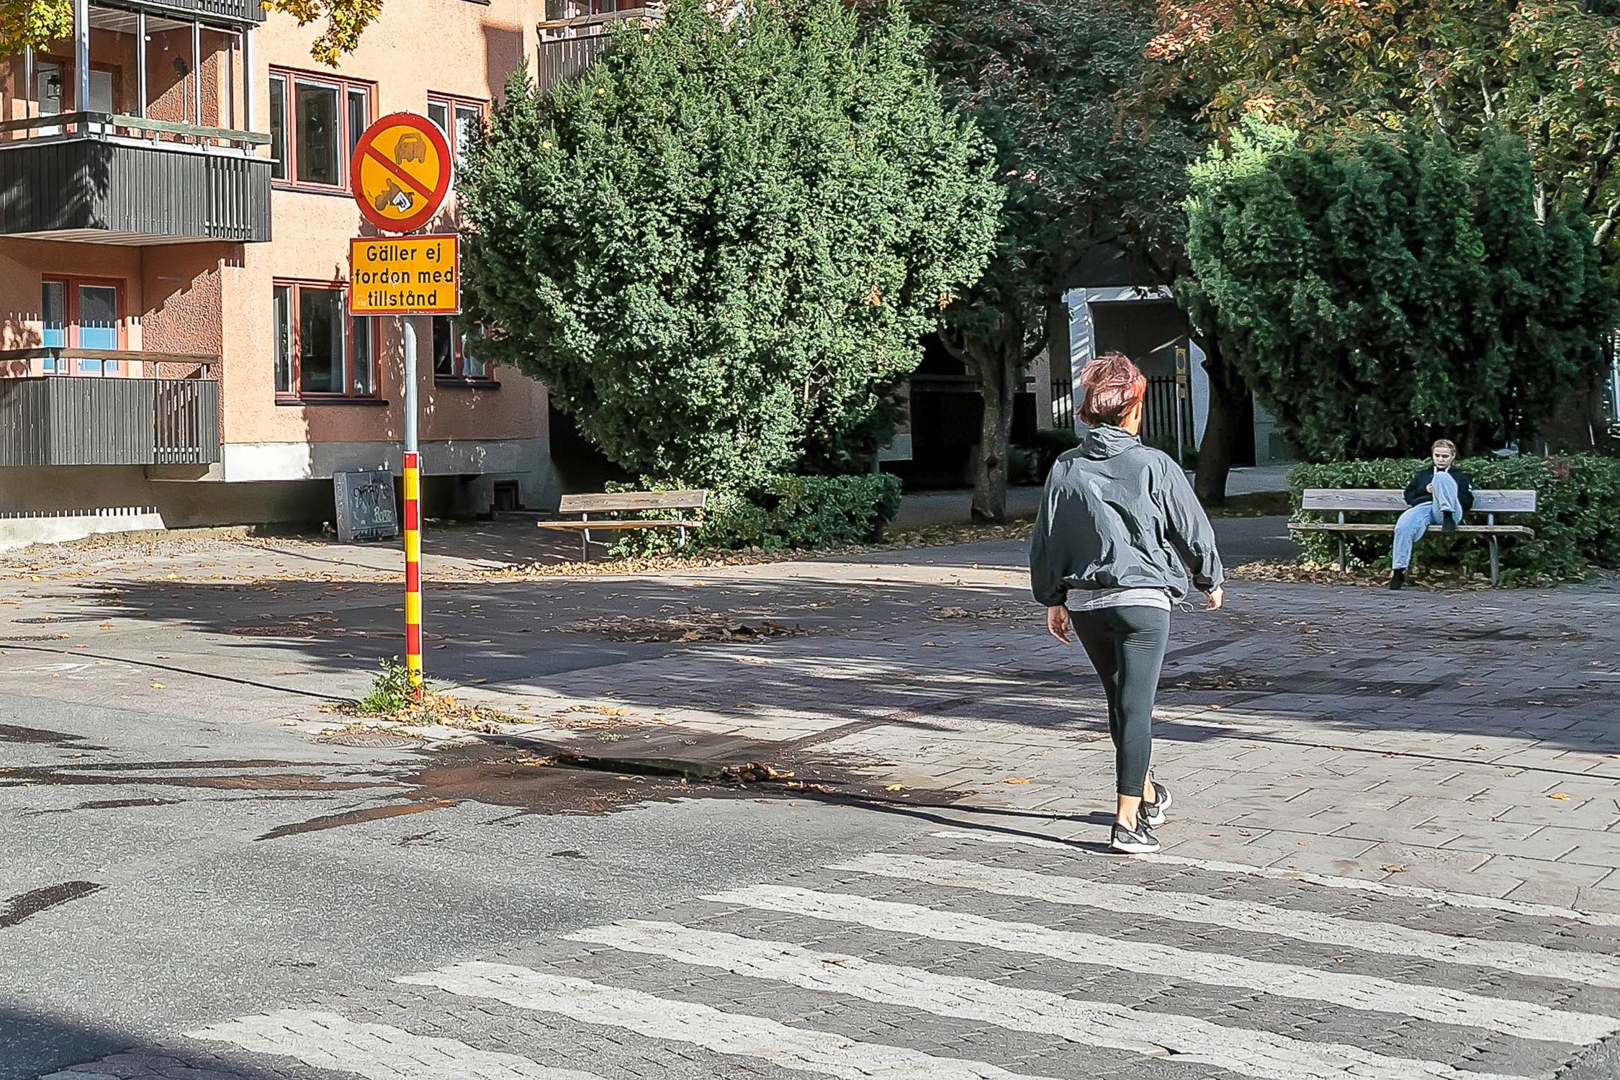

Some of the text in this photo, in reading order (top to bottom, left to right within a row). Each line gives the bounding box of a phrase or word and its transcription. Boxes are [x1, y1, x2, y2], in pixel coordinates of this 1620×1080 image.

[366, 242, 441, 263] Gäller ej
[355, 265, 454, 284] fordon med
[367, 289, 437, 307] tillstånd
